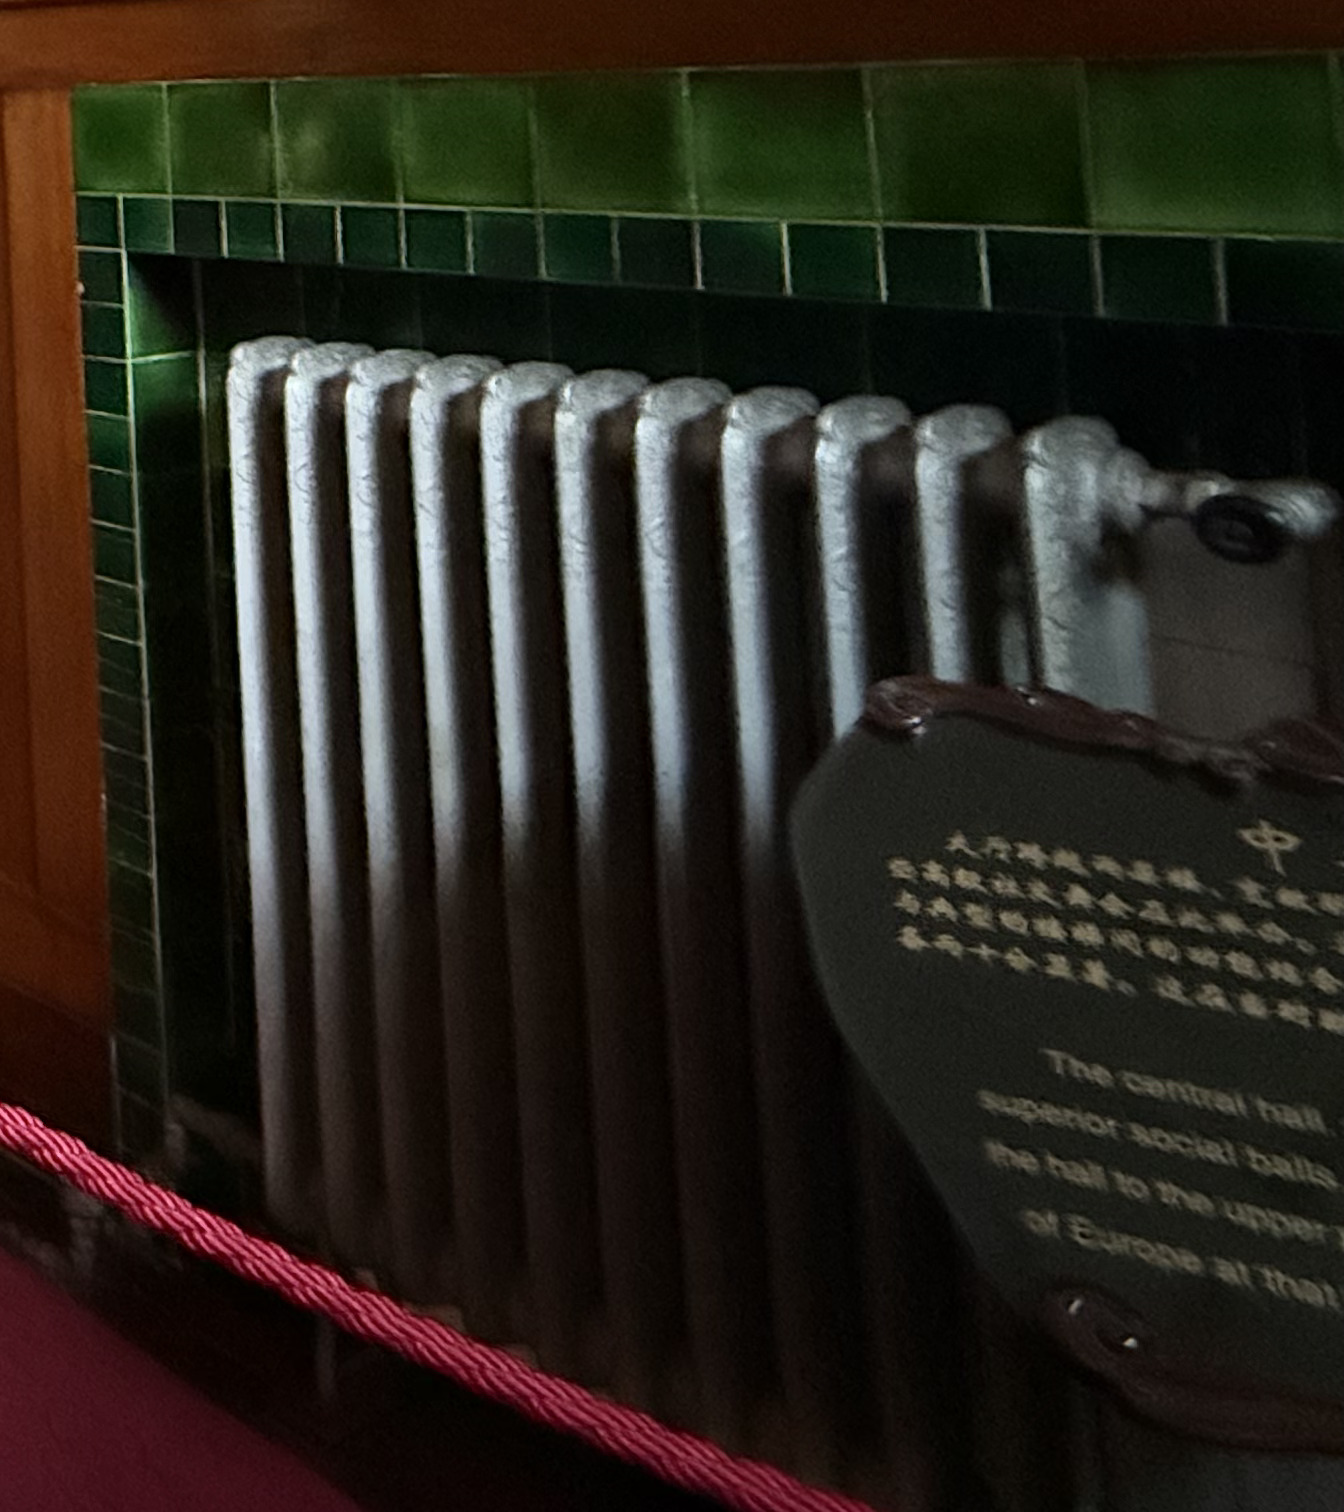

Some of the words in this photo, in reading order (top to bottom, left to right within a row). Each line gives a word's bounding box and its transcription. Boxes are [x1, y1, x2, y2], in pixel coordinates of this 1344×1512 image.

[1038, 1047, 1114, 1088] The
[1115, 1069, 1249, 1118] central
[976, 1090, 1118, 1139] superior
[1122, 1122, 1240, 1167] social
[983, 1137, 1041, 1175] the
[1043, 1149, 1110, 1192] hall
[1111, 1169, 1151, 1202] to
[1153, 1179, 1216, 1219] the
[1218, 1197, 1327, 1245] upper
[1020, 1208, 1061, 1239] of
[1062, 1213, 1203, 1274] Europe
[1207, 1255, 1255, 1291] at
